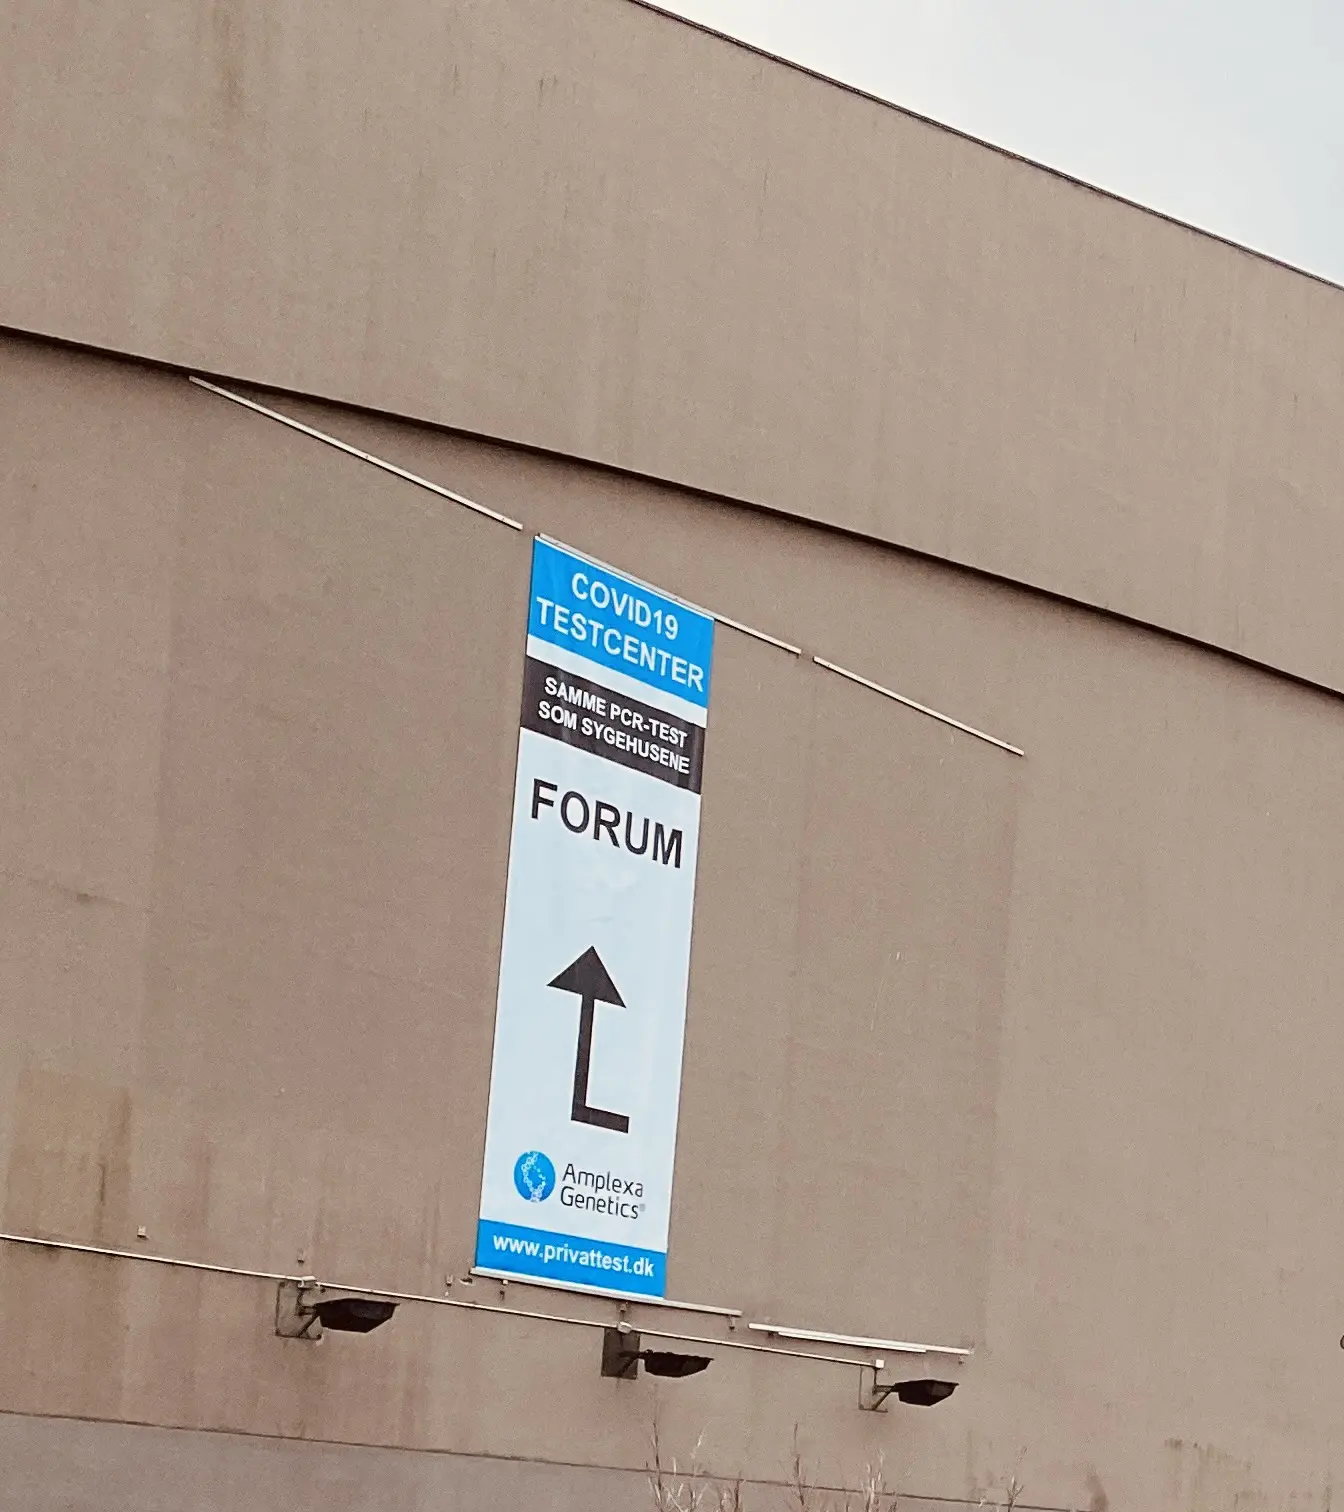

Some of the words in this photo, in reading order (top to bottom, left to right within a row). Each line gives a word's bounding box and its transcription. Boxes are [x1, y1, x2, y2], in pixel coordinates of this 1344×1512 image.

[572, 572, 679, 640] COVID19
[536, 596, 704, 692] TESTCENTER
[538, 700, 577, 731] SOM
[581, 717, 690, 775] SYGEHUSENE
[544, 677, 606, 716] SAMME
[610, 703, 688, 748] PCR-TEST
[531, 778, 683, 869] FORUM
[560, 1186, 640, 1219] Genetics
[562, 1163, 643, 1198] Amplexa
[493, 1234, 654, 1277] www.privattest.dk
